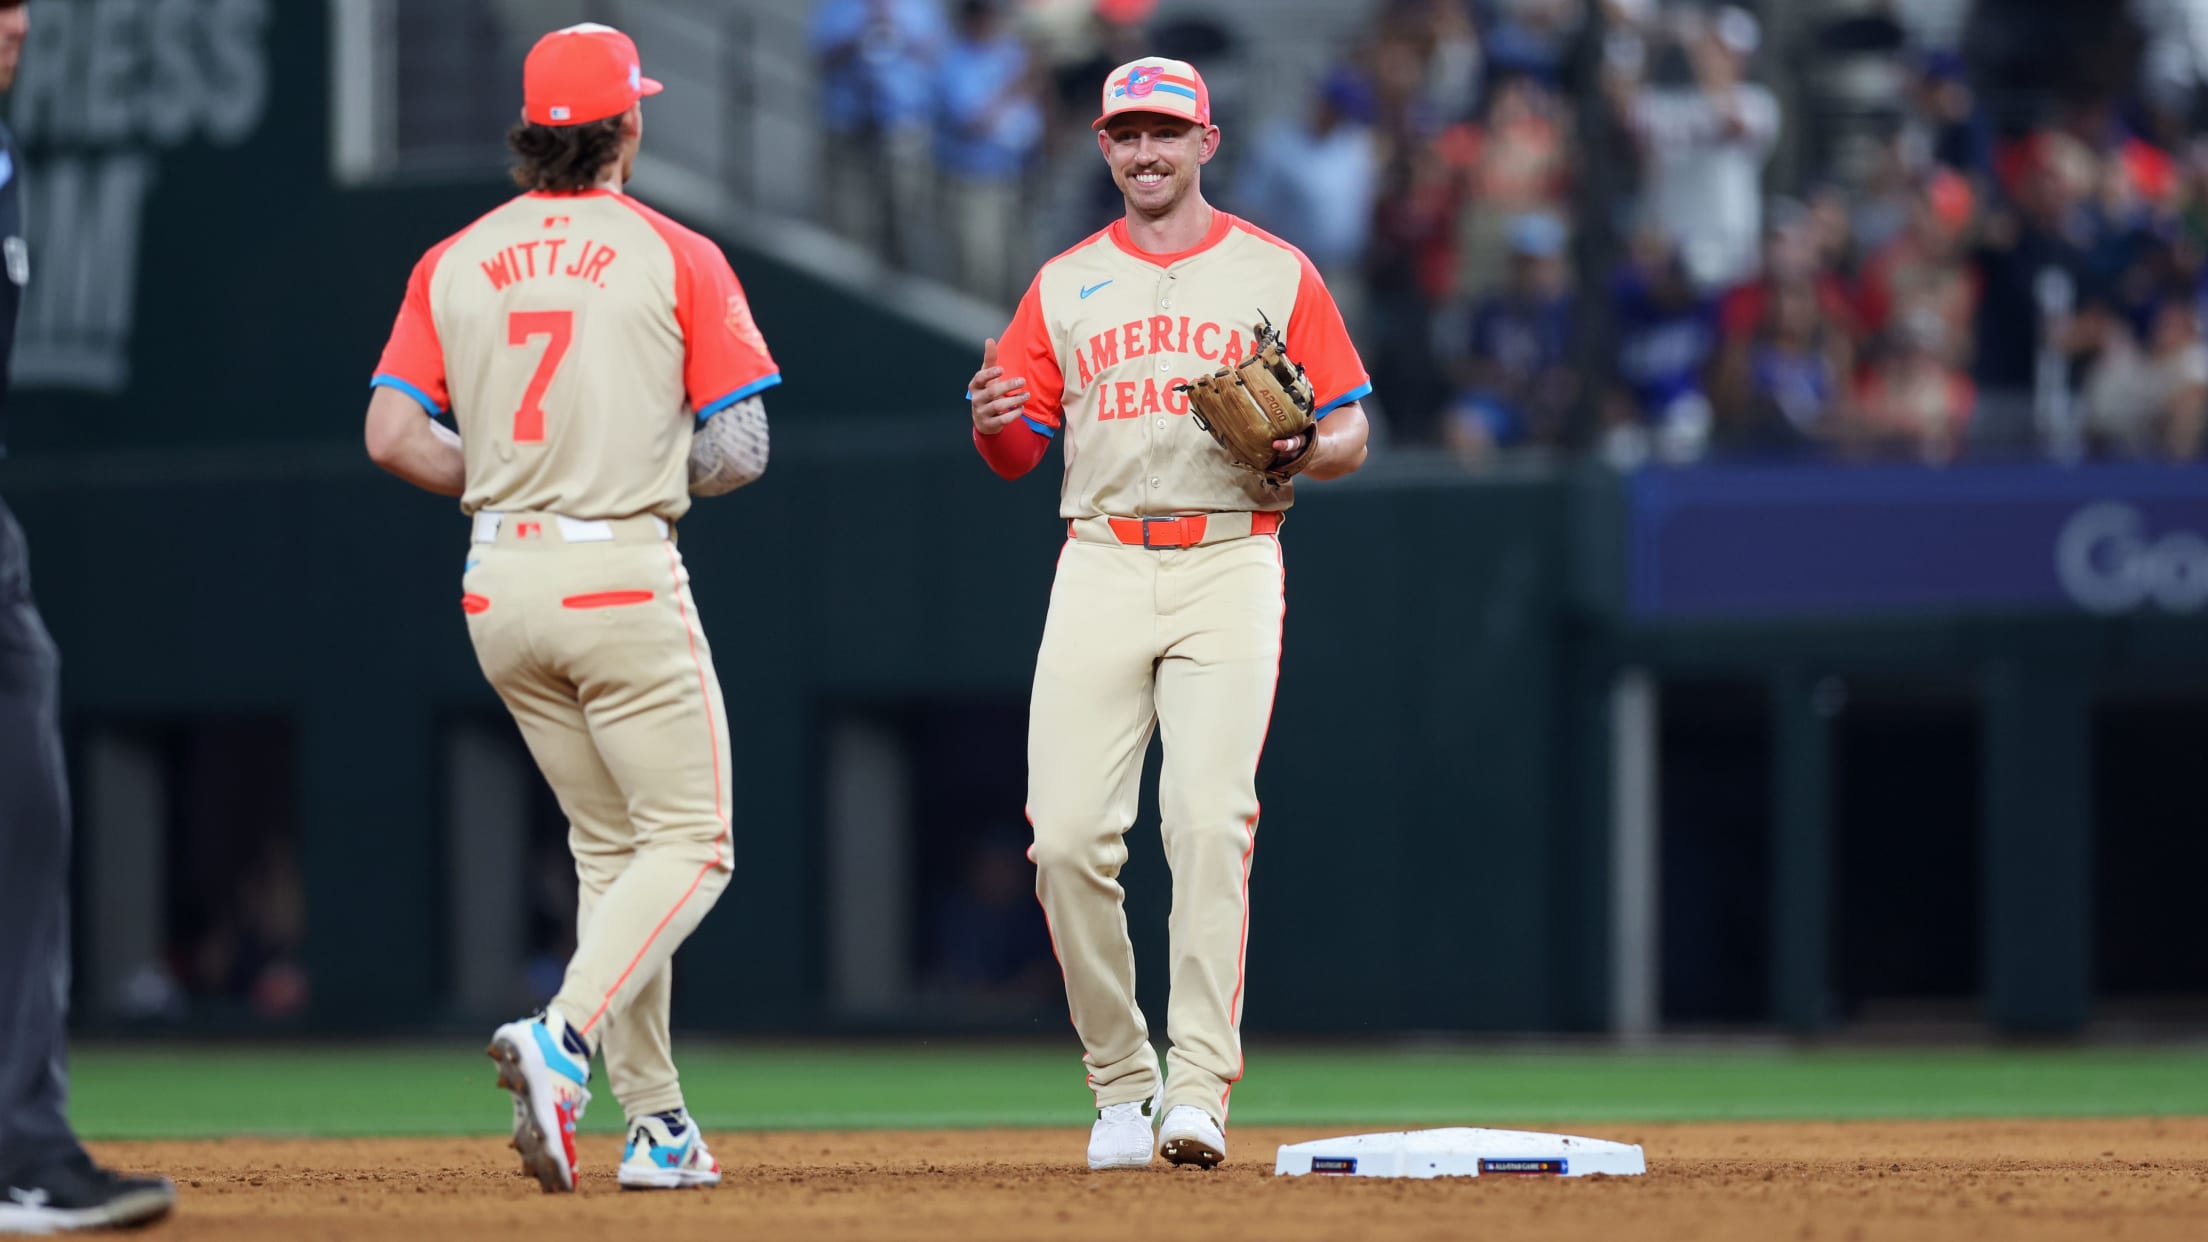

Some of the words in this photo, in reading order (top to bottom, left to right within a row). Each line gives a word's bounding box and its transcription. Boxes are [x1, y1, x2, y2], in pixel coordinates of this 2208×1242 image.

[480, 238, 566, 291] WITT
[565, 240, 616, 289] JR.
[508, 310, 573, 442] 7
[1075, 314, 1259, 390] AMERICA
[1097, 376, 1192, 422] LEAG
[1259, 387, 1287, 422] A2000
